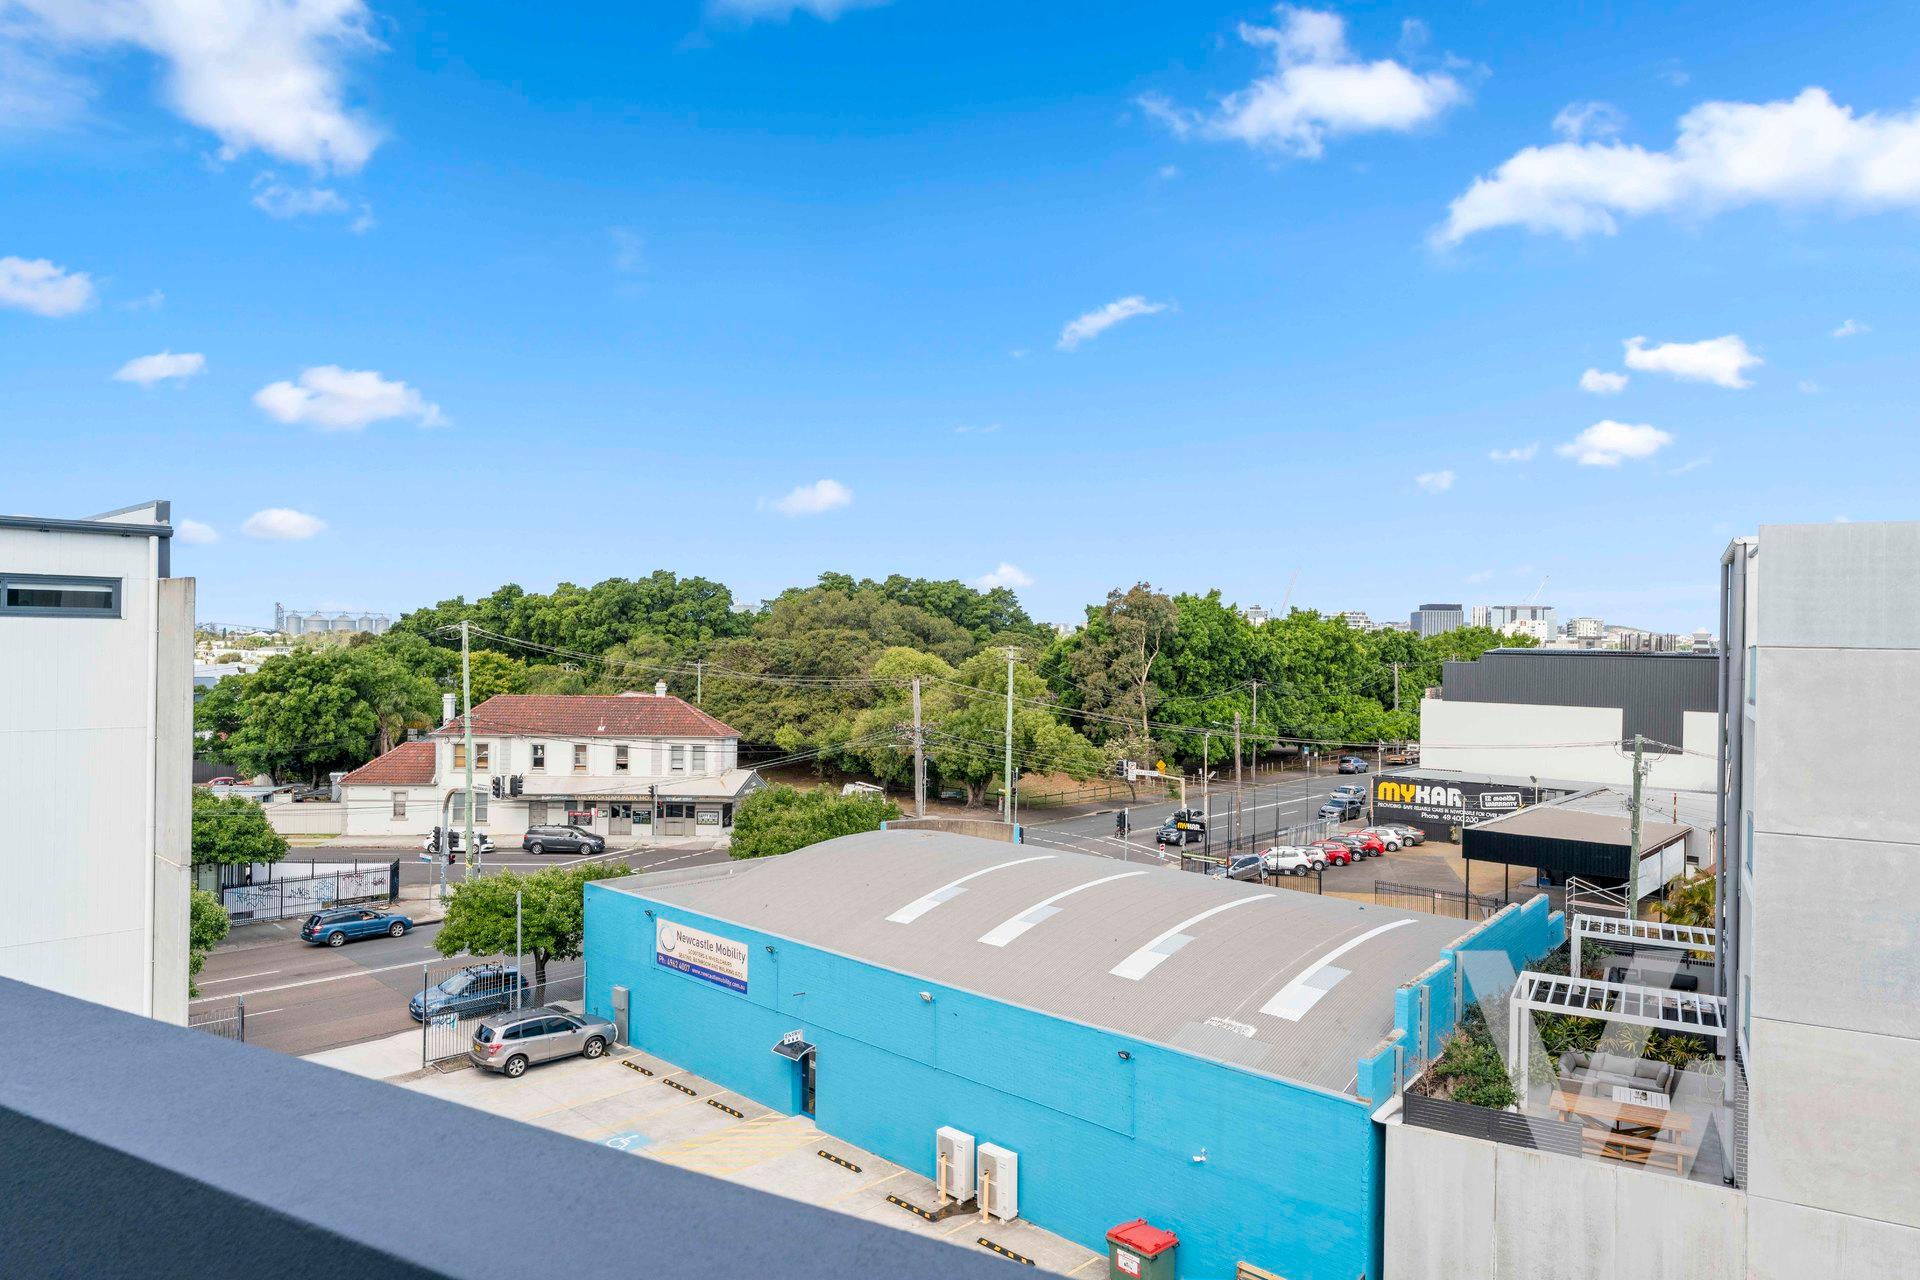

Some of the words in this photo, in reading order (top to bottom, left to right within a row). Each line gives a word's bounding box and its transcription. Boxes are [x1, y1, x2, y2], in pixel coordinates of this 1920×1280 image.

[1378, 782, 1462, 807] MYKAR
[1421, 811, 1439, 819] Phone
[676, 930, 714, 951] Newcastle
[715, 942, 746, 964] Mobility
